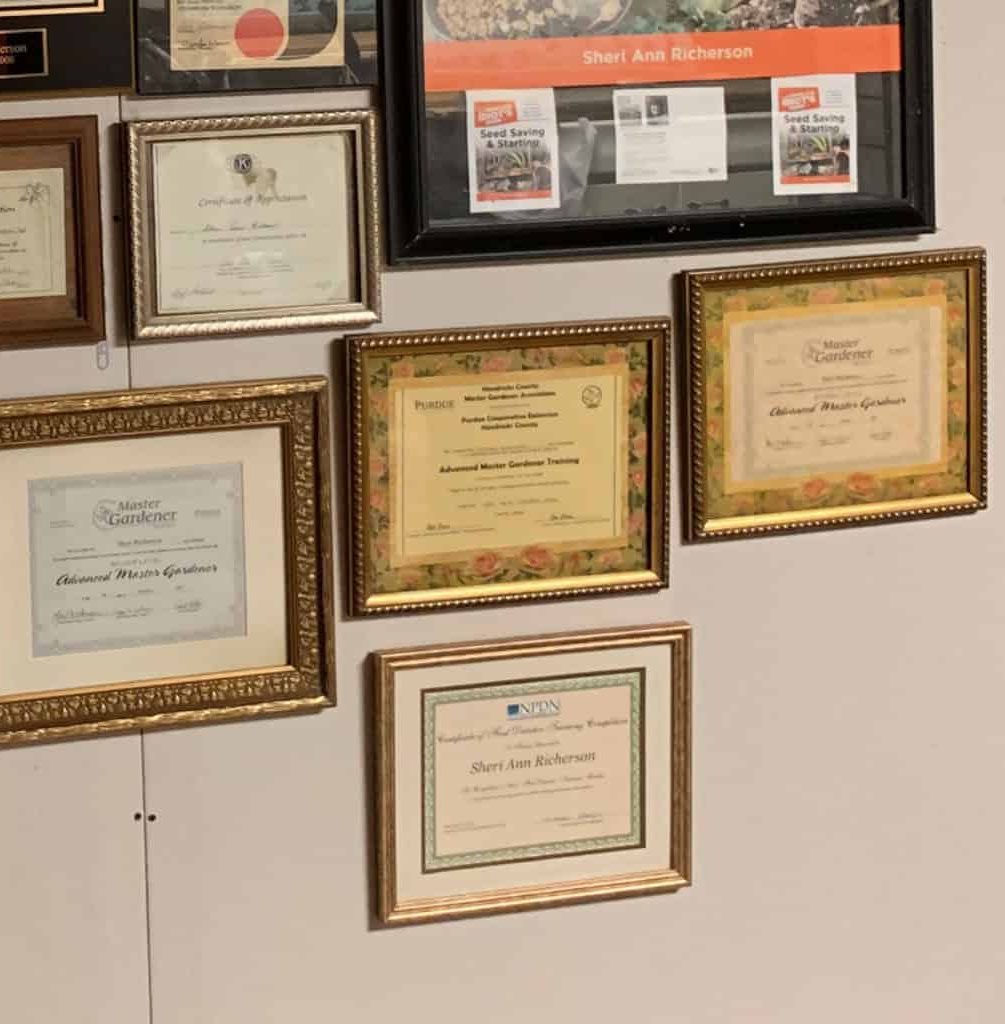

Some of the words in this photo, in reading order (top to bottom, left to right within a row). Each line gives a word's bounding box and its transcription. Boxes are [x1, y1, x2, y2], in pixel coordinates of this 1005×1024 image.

[582, 50, 626, 66] Sheri
[633, 48, 665, 63] Ann
[671, 45, 753, 62] Richerson
[480, 129, 507, 138] Seed
[116, 500, 162, 512] Master
[108, 510, 178, 526] Gardener
[55, 571, 111, 586] Advanced
[115, 567, 160, 580] Master
[162, 564, 217, 578] Gardener
[519, 699, 561, 714] NPDN
[470, 759, 504, 775] Sheri
[506, 756, 531, 770] Ann
[534, 750, 597, 768] Richerson
